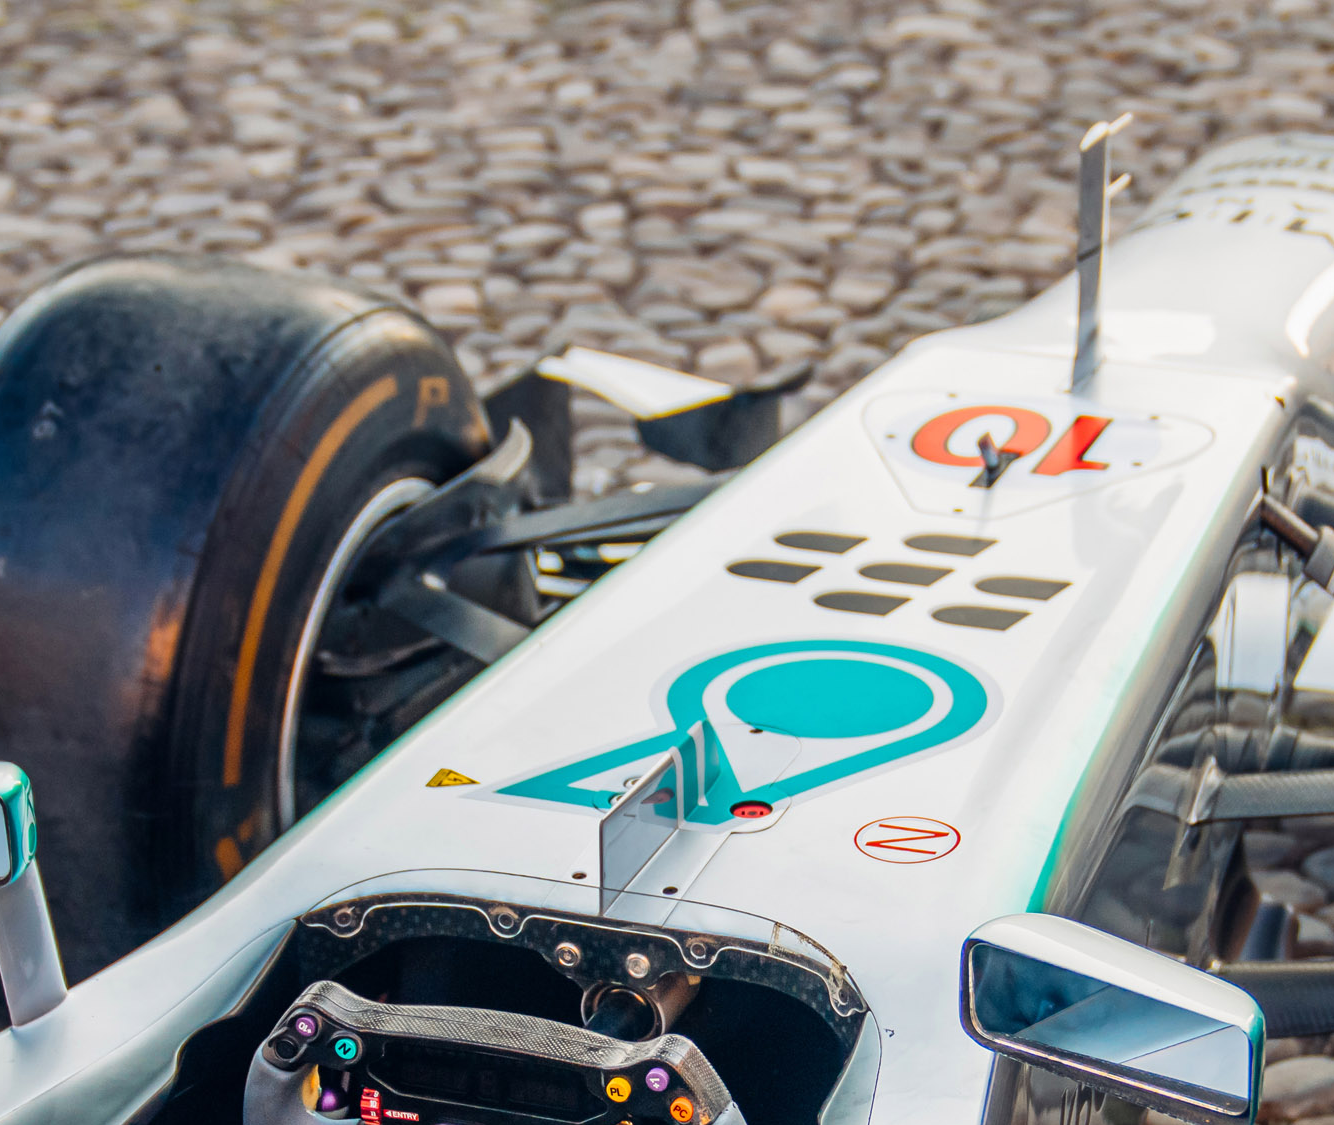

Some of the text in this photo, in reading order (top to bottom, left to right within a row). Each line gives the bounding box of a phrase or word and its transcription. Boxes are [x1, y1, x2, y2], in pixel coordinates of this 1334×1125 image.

[338, 1042, 352, 1055] N
[610, 1087, 624, 1097] PL
[392, 1111, 419, 1121] ENTRY
[673, 1105, 688, 1119] PC
